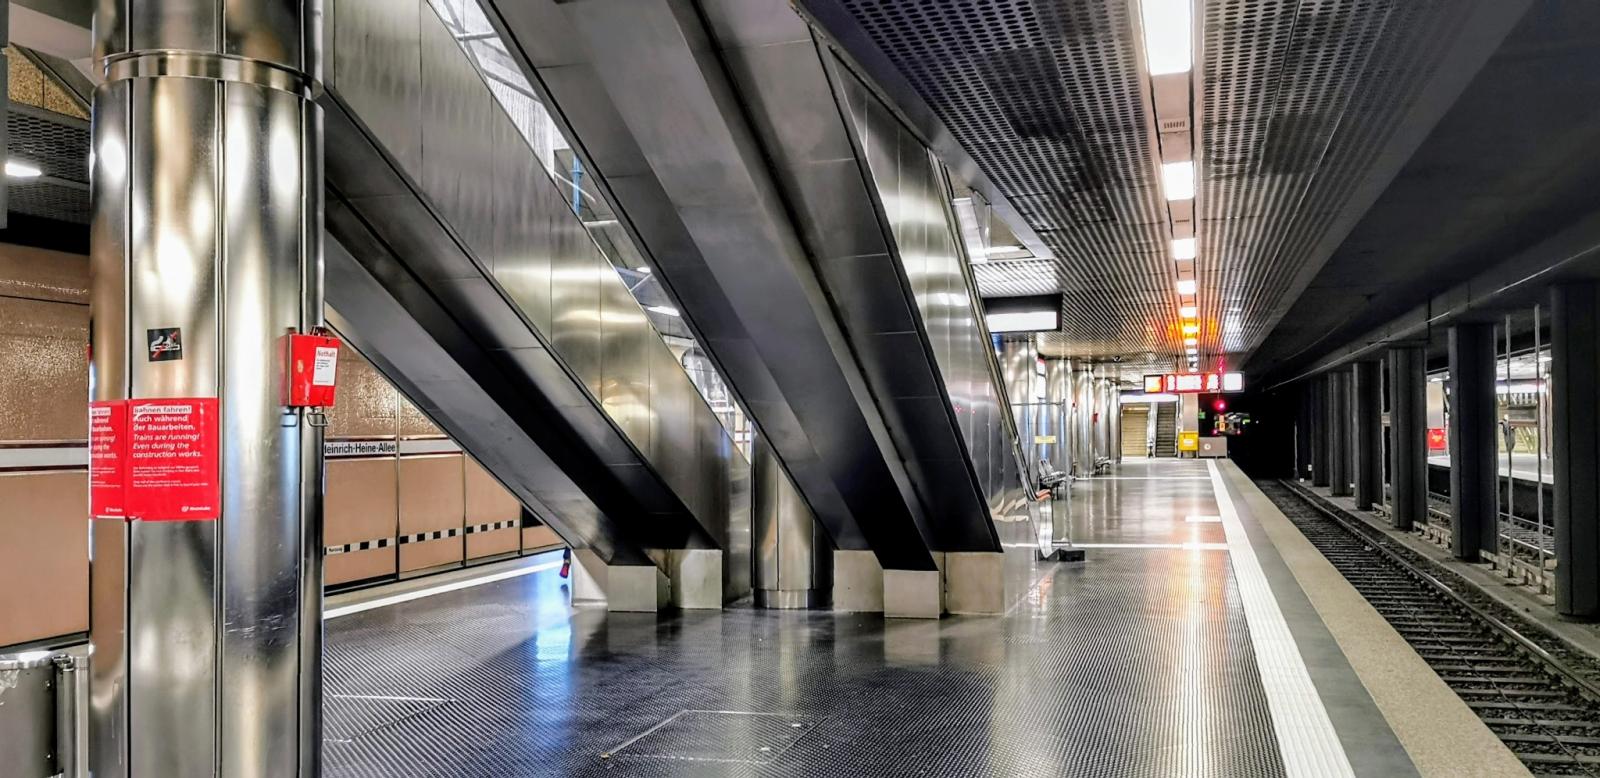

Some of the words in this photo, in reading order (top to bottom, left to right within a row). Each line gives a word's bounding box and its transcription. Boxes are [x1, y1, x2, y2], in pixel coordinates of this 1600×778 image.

[163, 404, 191, 413] fahren!
[154, 413, 189, 422] während
[133, 423, 146, 431] der
[133, 433, 154, 441] Trains
[168, 433, 200, 442] running!
[151, 442, 176, 451] during
